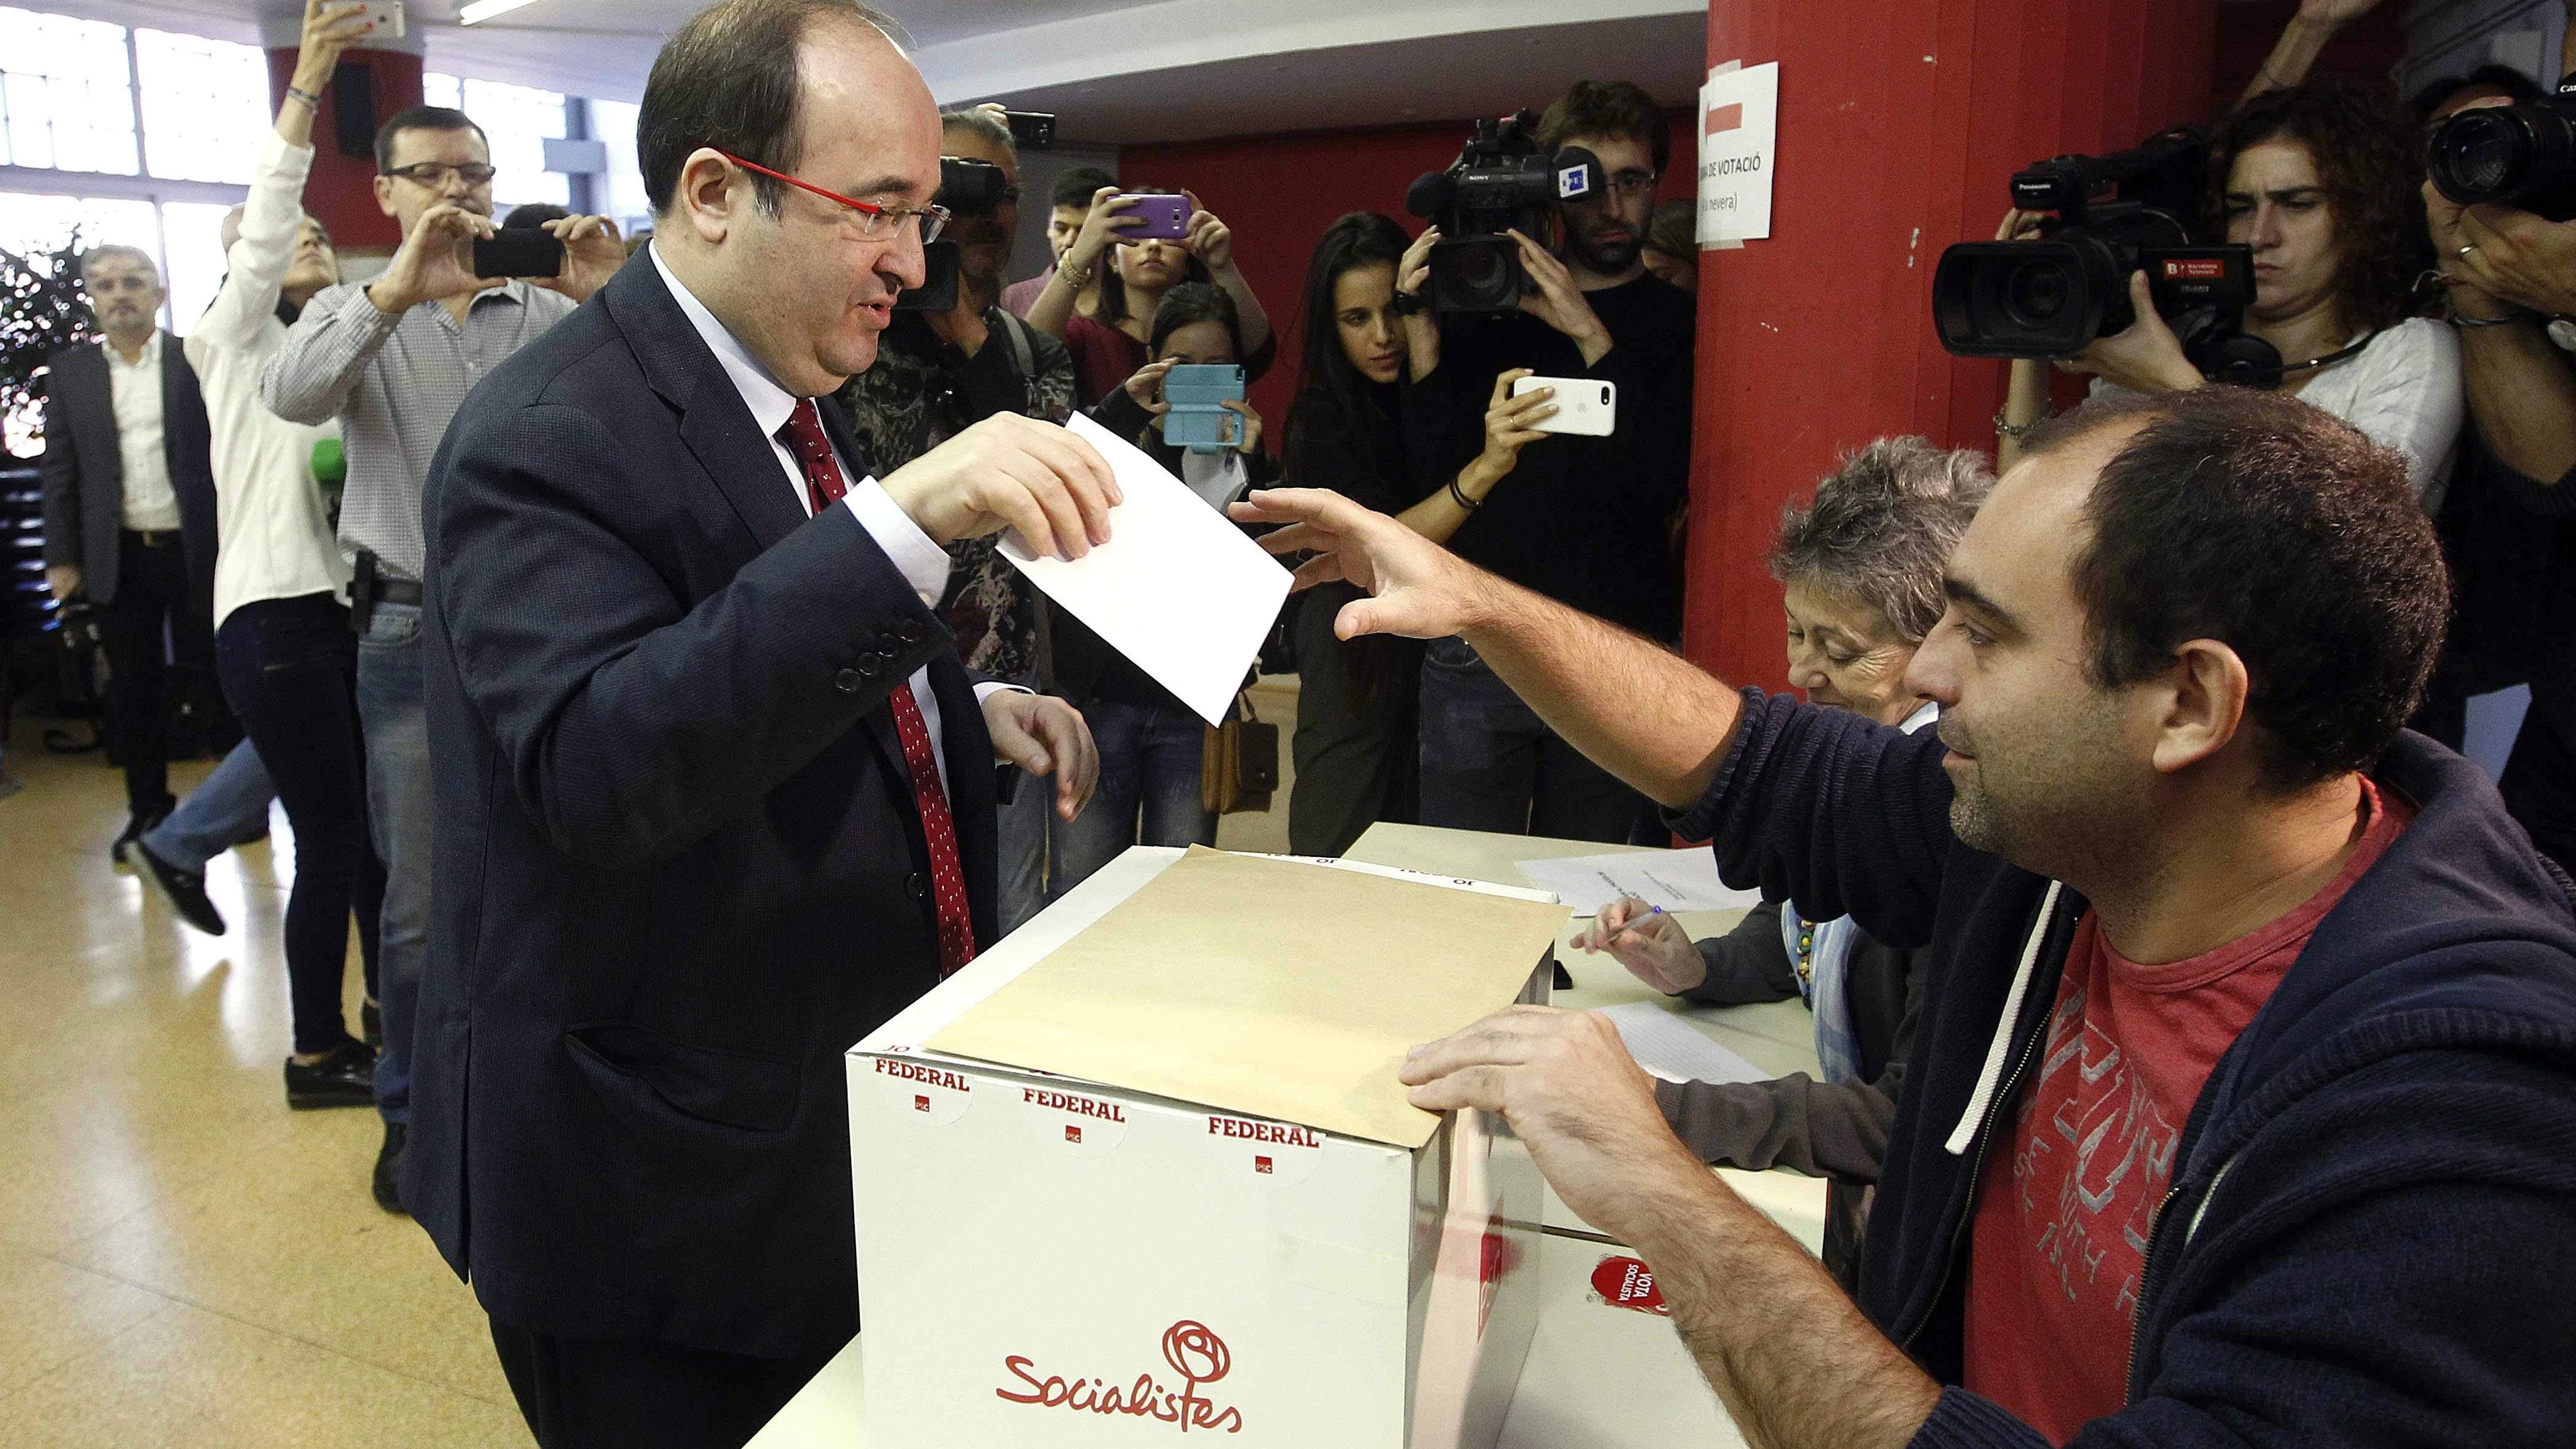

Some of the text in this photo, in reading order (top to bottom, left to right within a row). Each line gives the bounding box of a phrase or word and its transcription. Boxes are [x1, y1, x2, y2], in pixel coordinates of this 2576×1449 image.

[1718, 151, 1761, 175] VOTACIÓ
[1709, 192, 1738, 212] nevera)
[2167, 262, 2178, 275] B
[875, 1058, 970, 1093] FEDERAL
[1023, 1088, 1125, 1123] FEDERAL
[1209, 1116, 1320, 1149] FEDERAL
[1617, 1263, 1640, 1301] SOCIALISTA
[1632, 1273, 1653, 1298] VOTA
[995, 1354, 1243, 1434] Socialistes
